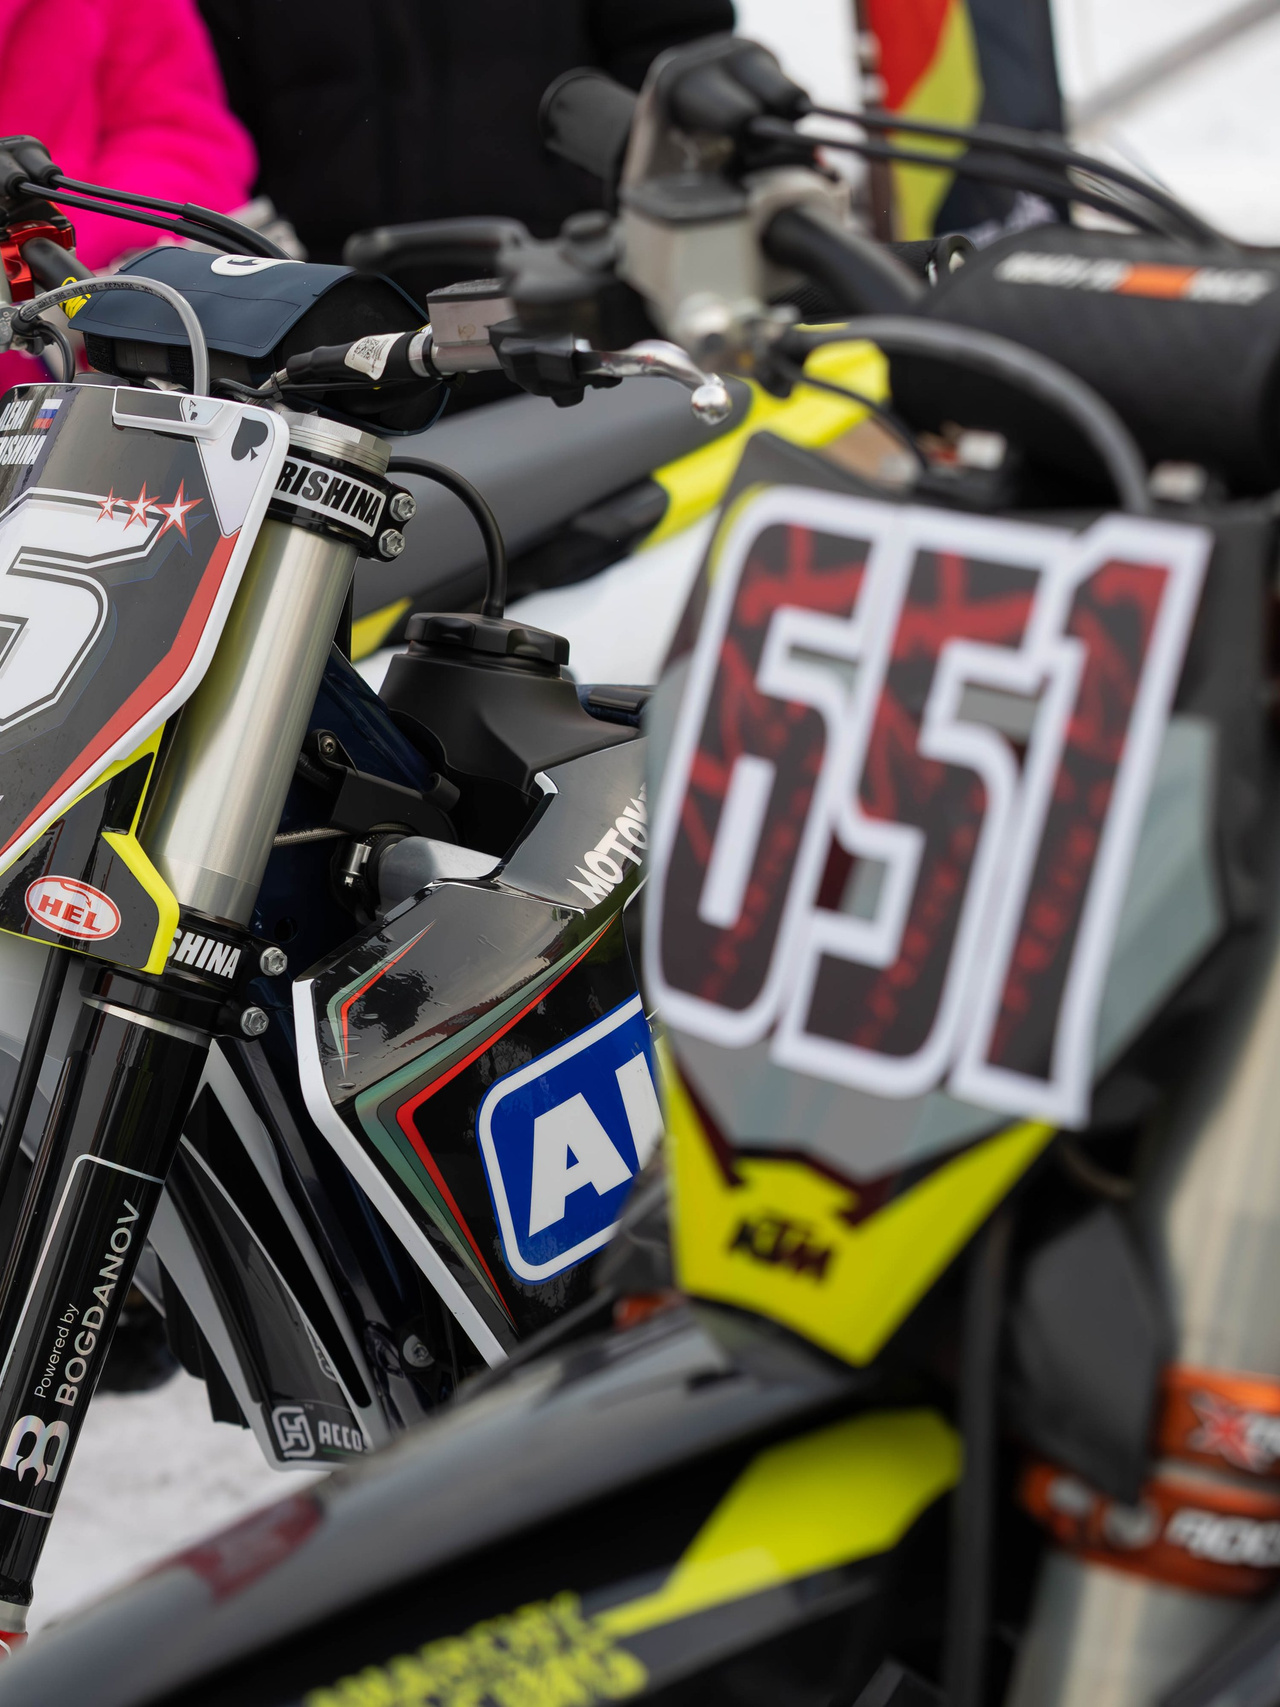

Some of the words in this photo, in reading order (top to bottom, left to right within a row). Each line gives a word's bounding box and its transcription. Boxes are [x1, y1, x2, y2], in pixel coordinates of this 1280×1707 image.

[646, 488, 1210, 1128] 651
[37, 894, 102, 933] HEL
[33, 1326, 71, 1399] Powered
[59, 1302, 80, 1326] by
[54, 1199, 140, 1407] BOGDANOV
